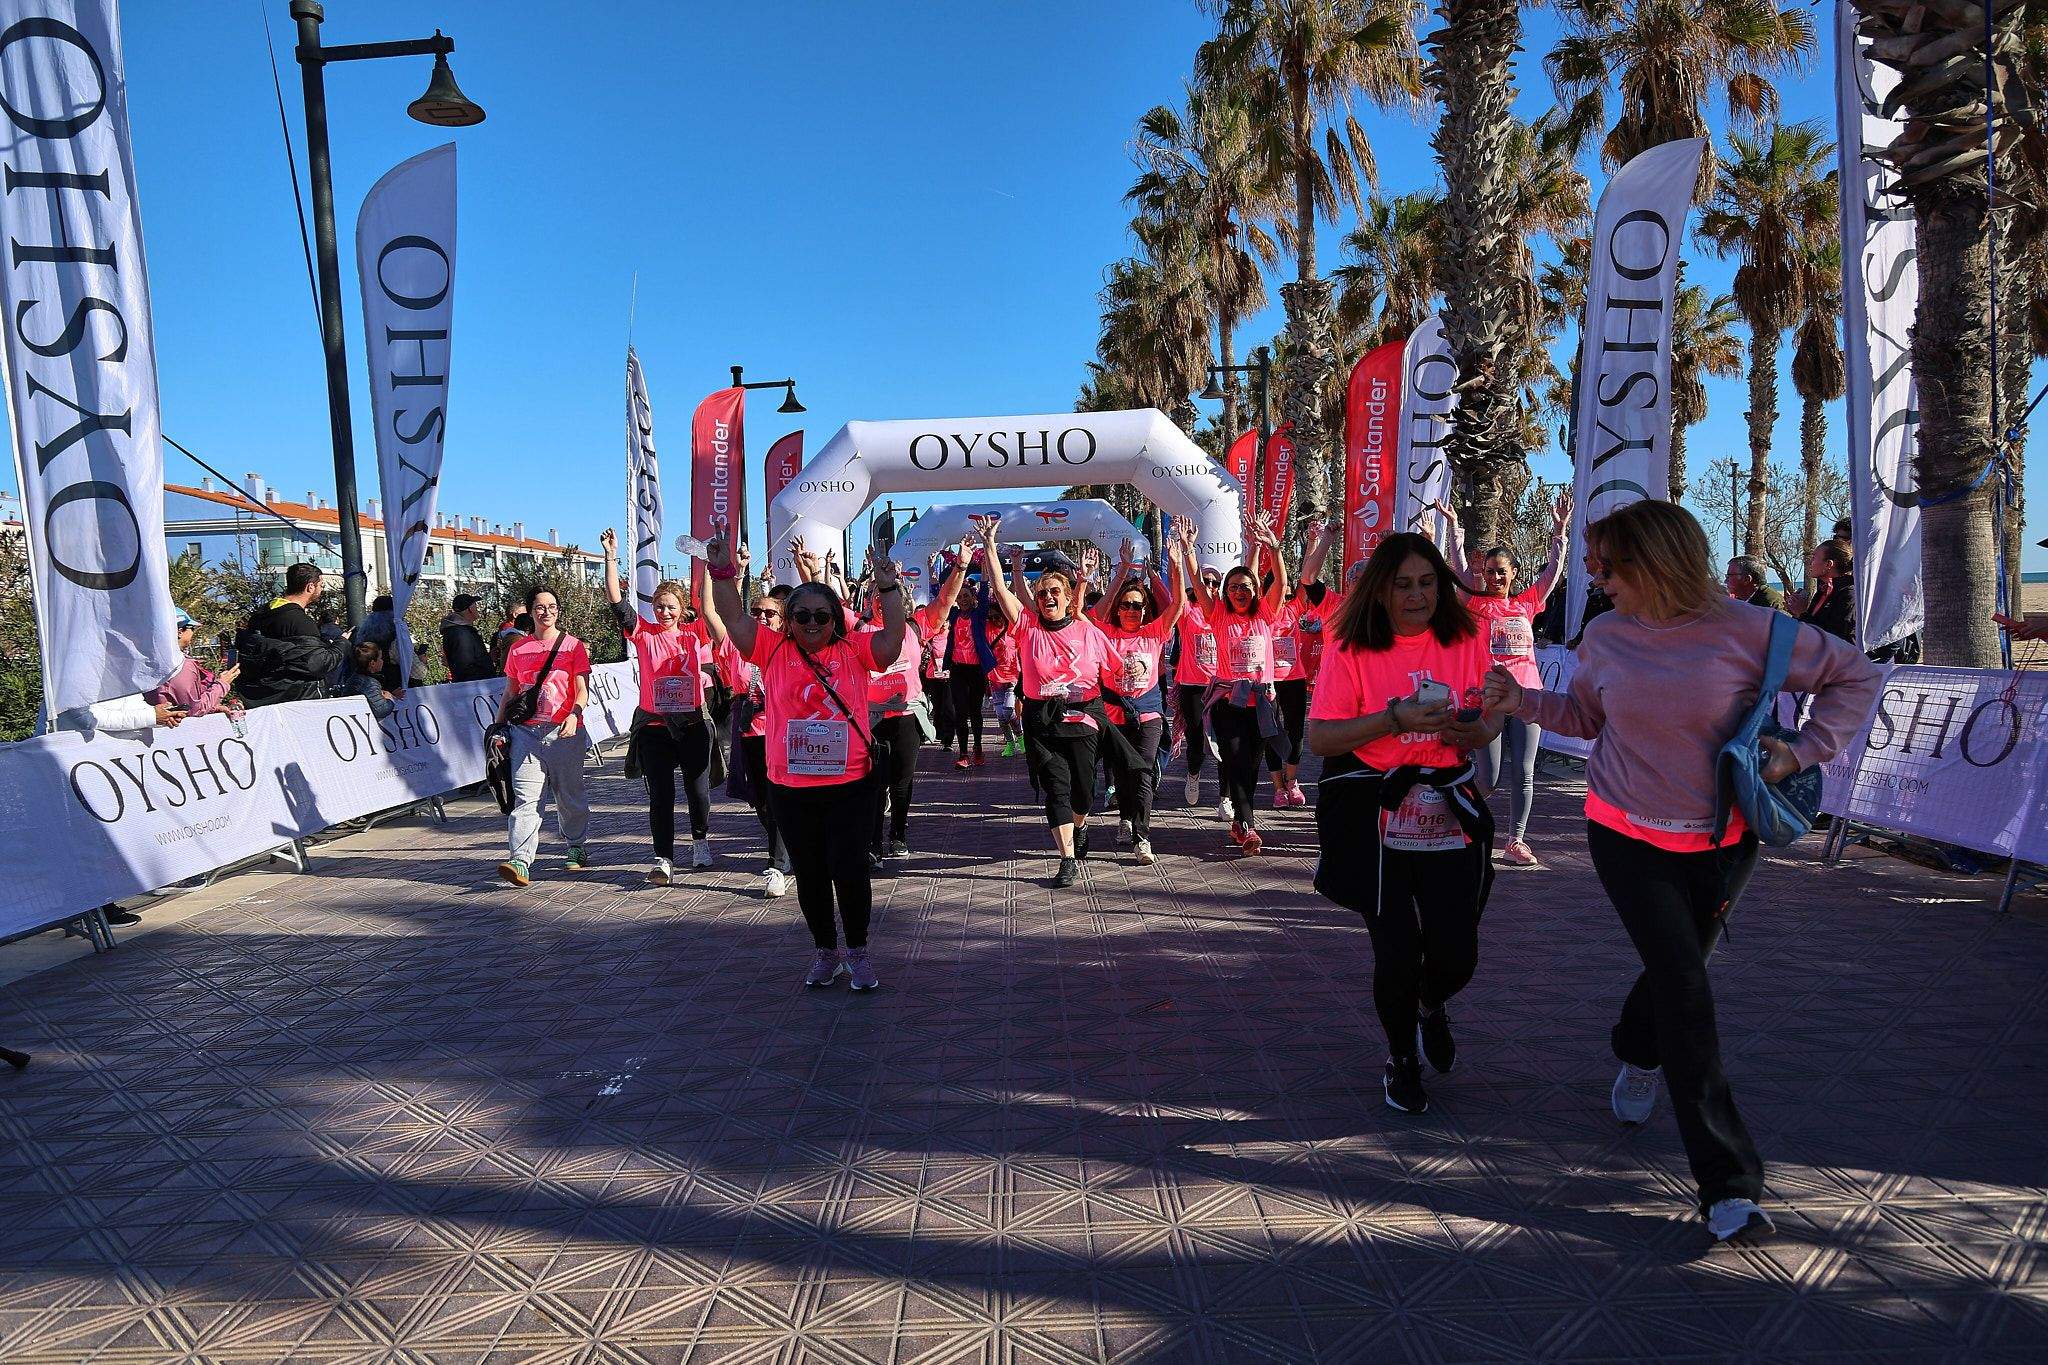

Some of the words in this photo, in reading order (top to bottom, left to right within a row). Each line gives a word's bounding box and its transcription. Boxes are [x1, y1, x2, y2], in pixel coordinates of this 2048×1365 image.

[0, 17, 142, 590] OYSHO
[1359, 377, 1387, 496] Santander
[1407, 354, 1458, 530] YSHO
[908, 427, 1097, 471] OYSHO
[709, 419, 729, 527] Santander
[1151, 463, 1208, 479] OYSHO
[799, 480, 855, 494] OYSHO
[1195, 541, 1237, 555] YSHO
[777, 557, 827, 570] OYO
[1506, 633, 1523, 641] 016
[1241, 651, 1256, 659] 016
[668, 691, 684, 699] 016
[325, 704, 440, 762] OYSHO
[806, 744, 830, 754] 016
[69, 737, 257, 824] OYSHO
[1417, 813, 1447, 826] 016
[153, 815, 233, 846] WWW.OYSHO.COM
